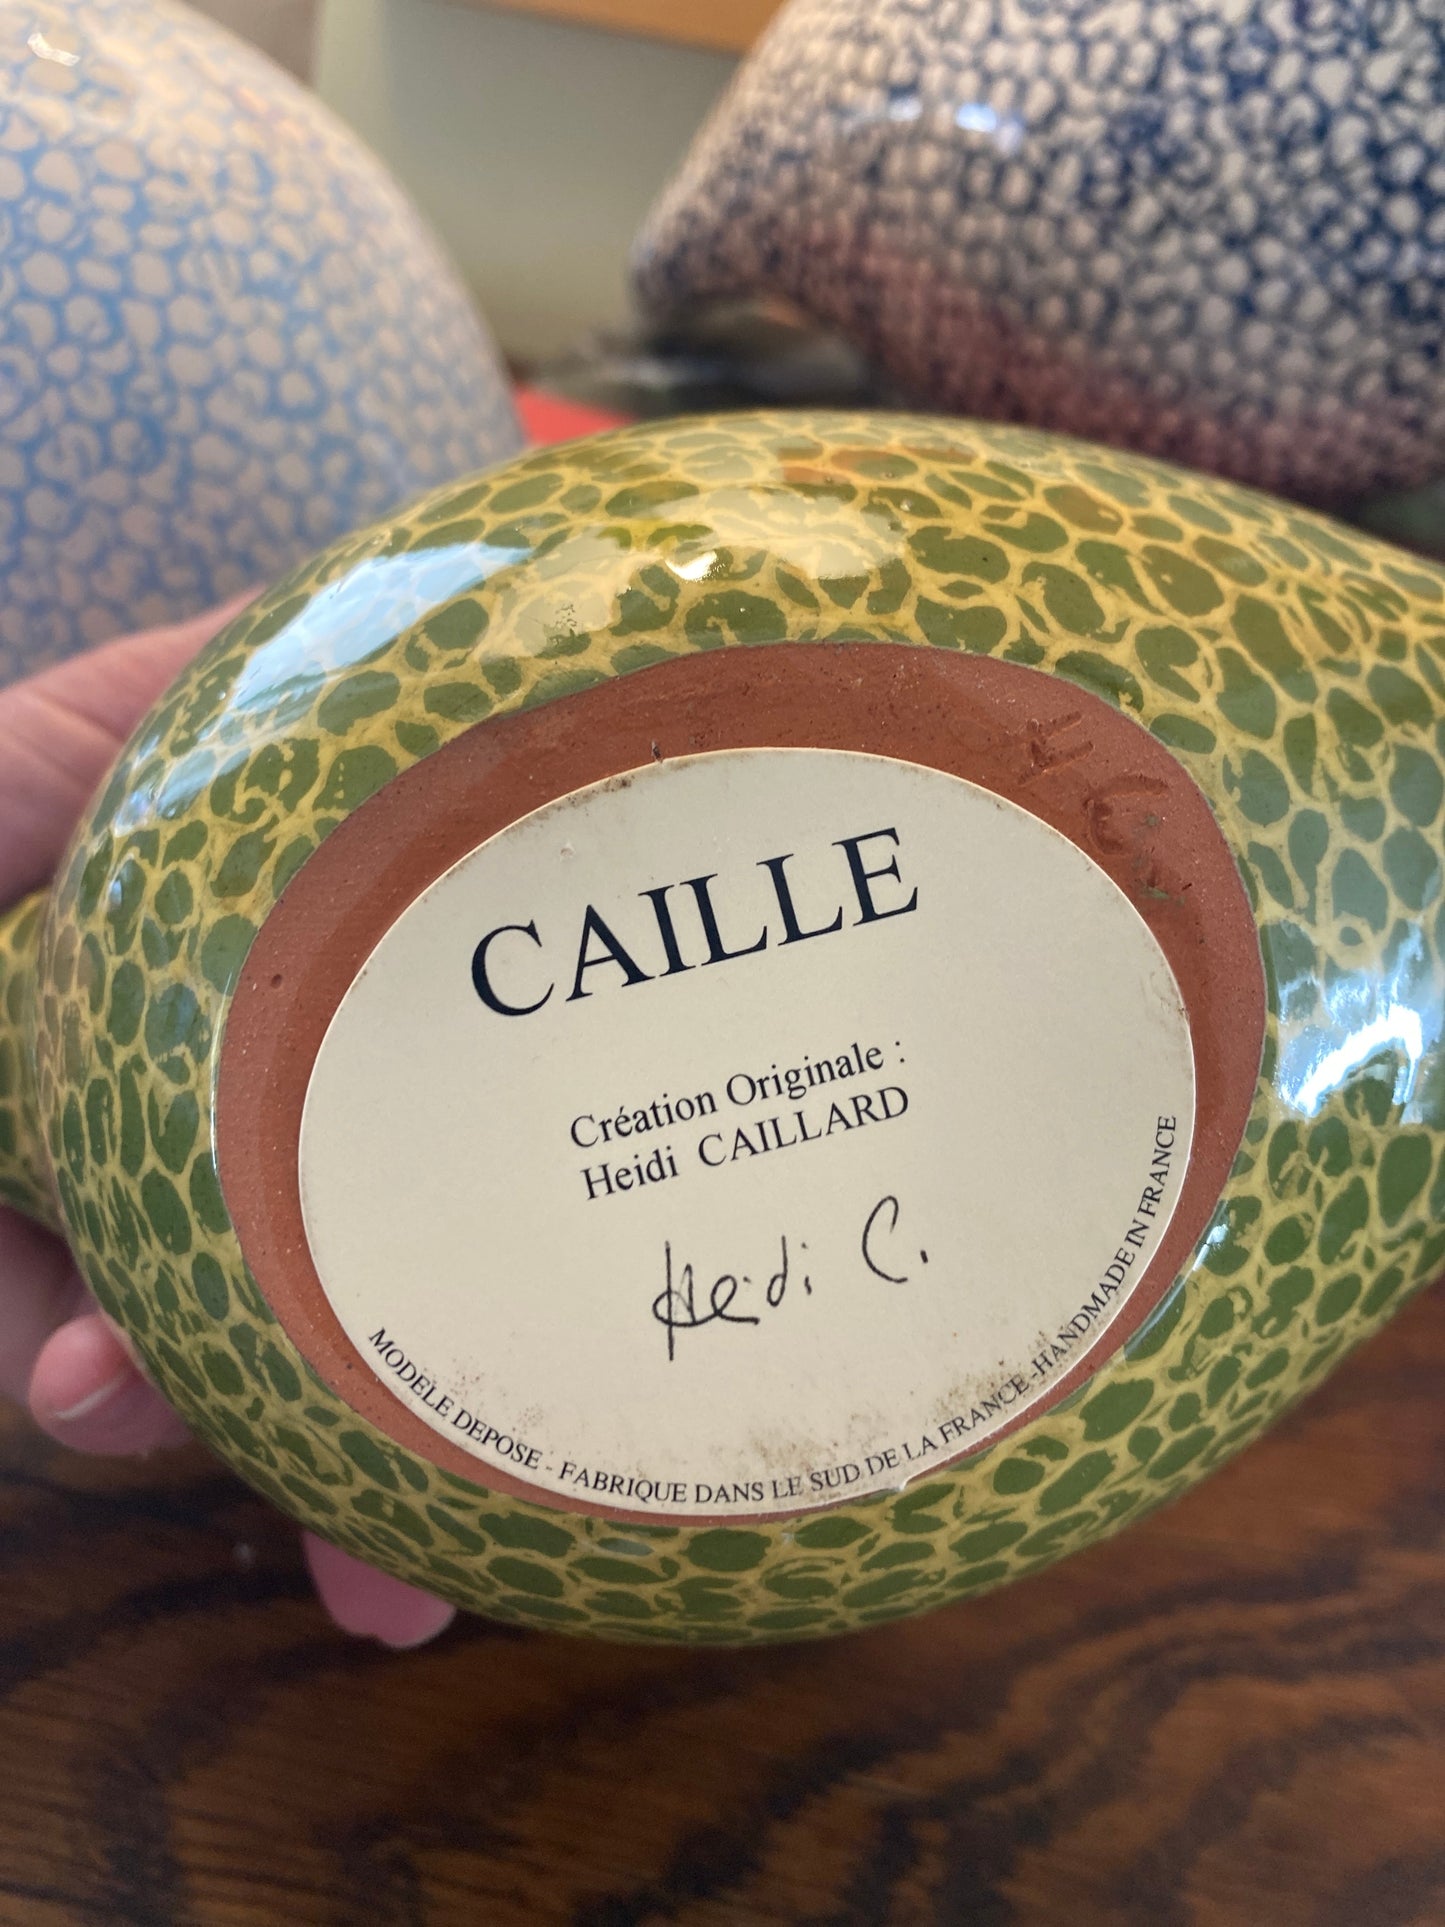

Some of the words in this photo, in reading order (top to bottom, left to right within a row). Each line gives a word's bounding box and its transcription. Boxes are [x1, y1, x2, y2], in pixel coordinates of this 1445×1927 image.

[470, 826, 919, 1017] CAILLE
[570, 1092, 718, 1149] Création
[725, 1041, 885, 1101] Originale
[580, 1145, 680, 1201] Heidi
[697, 1085, 910, 1168] CAILLARD
[1137, 1114, 1177, 1219] FRANCE
[1125, 1218, 1150, 1249] IN
[937, 1372, 1031, 1445] FRANCE
[450, 1407, 544, 1470] DEPOSE
[902, 1434, 939, 1462] LA
[557, 1461, 688, 1504] FABRIQUE
[810, 1463, 861, 1493] SUD
[864, 1448, 902, 1477] DE
[694, 1480, 764, 1504] DANS
[771, 1476, 802, 1500] LE
